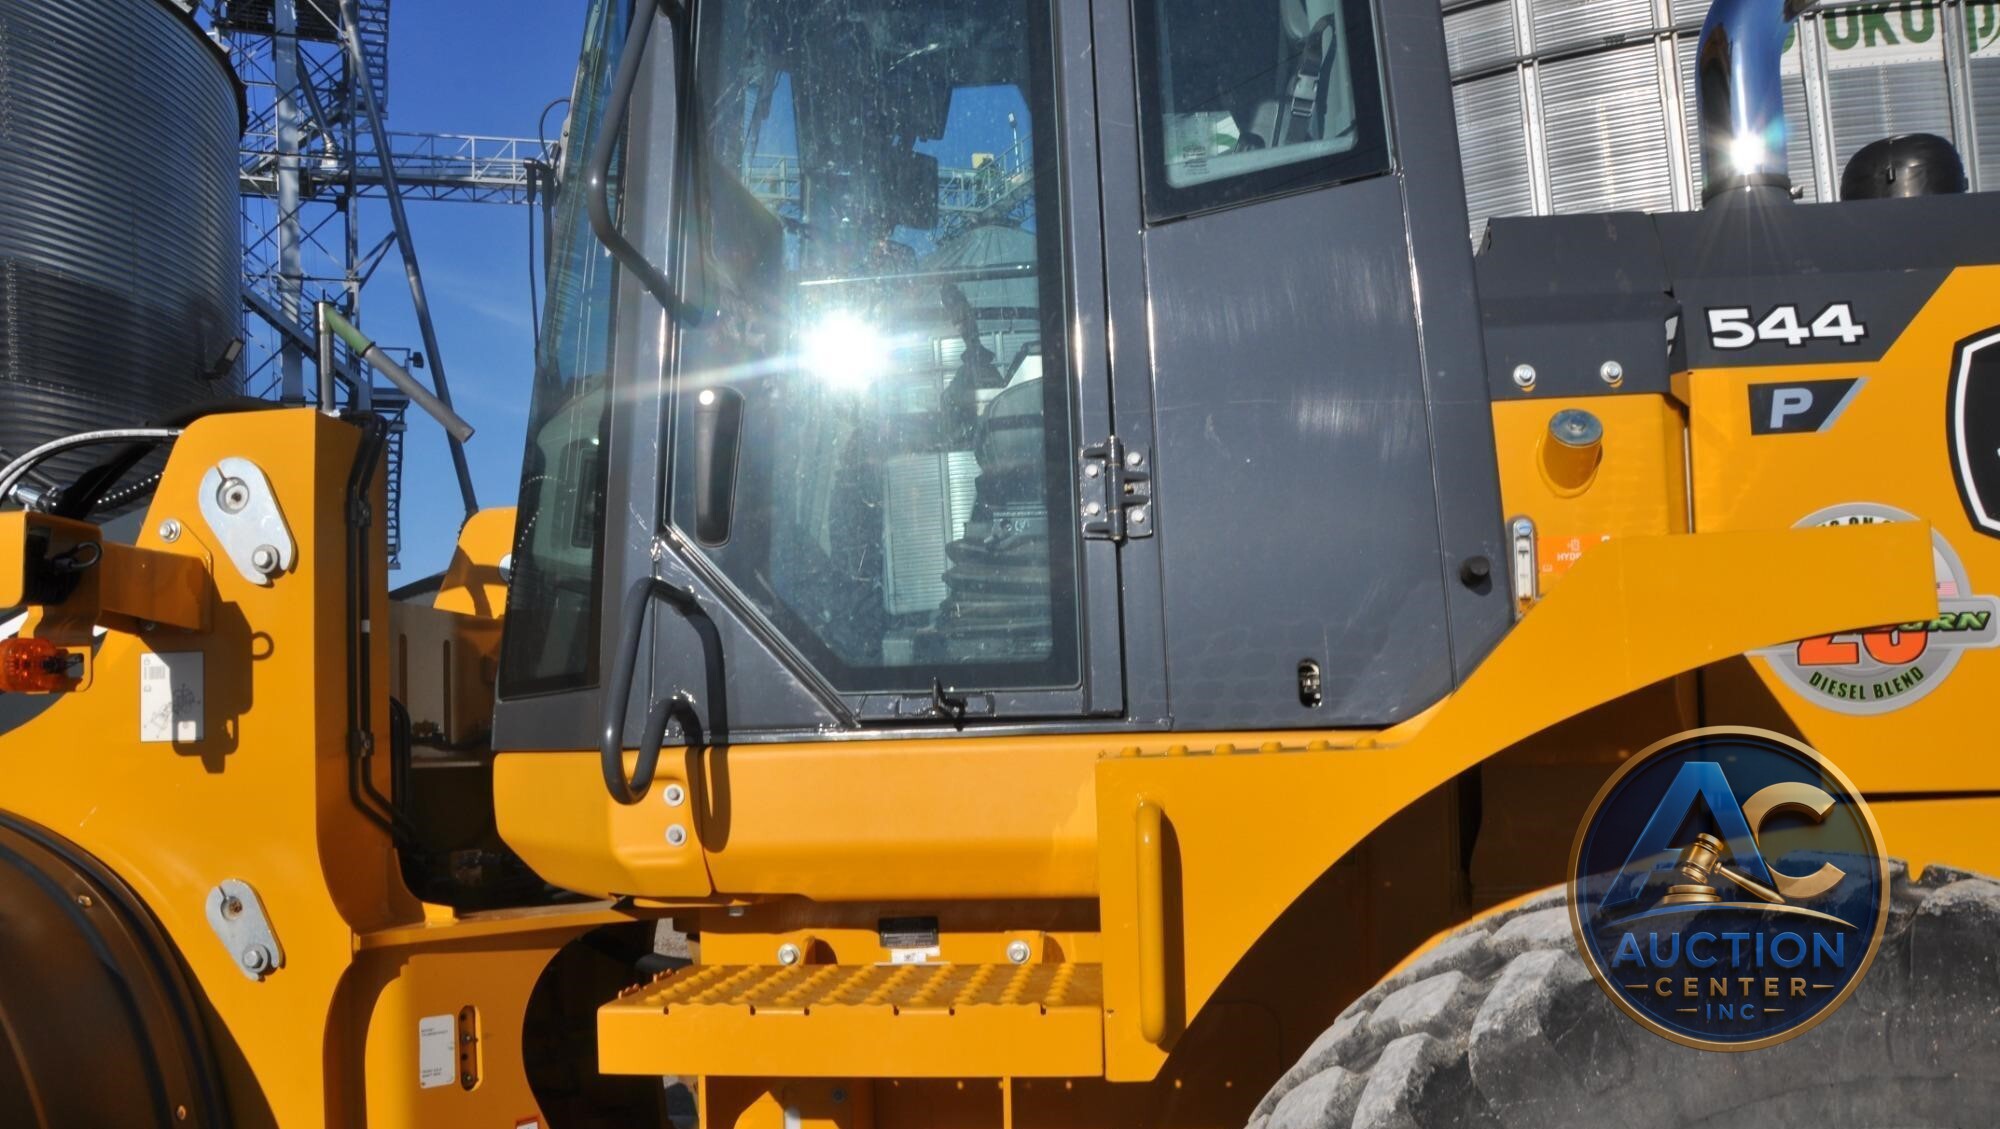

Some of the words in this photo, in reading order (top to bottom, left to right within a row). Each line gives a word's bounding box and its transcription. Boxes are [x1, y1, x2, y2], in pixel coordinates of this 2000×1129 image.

[1705, 302, 1866, 349] 544
[1769, 387, 1814, 429] P
[1809, 671, 1866, 700] DIESEL
[1873, 666, 1924, 699] BLEND
